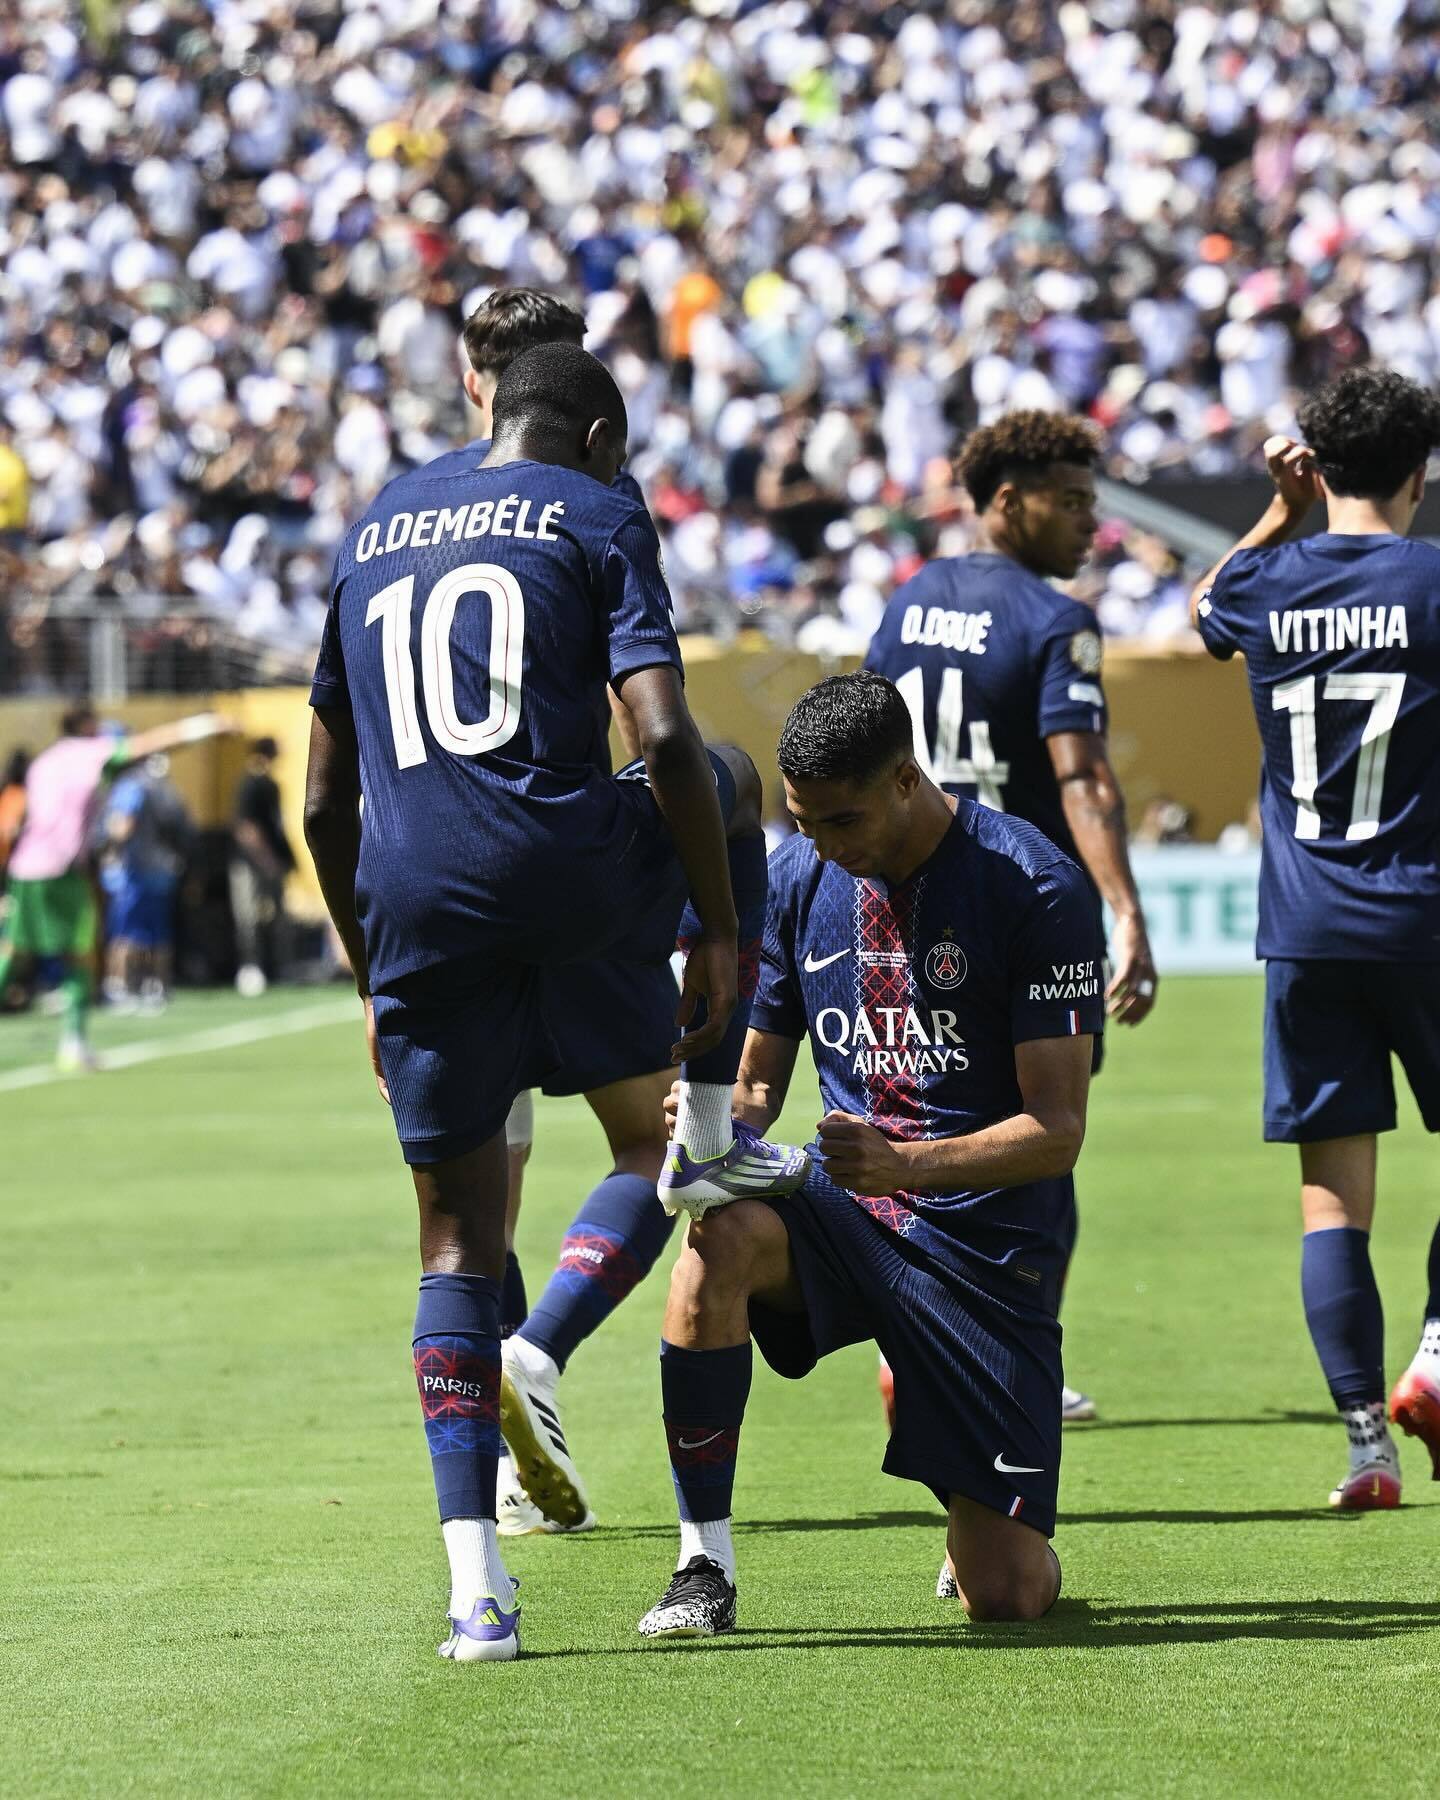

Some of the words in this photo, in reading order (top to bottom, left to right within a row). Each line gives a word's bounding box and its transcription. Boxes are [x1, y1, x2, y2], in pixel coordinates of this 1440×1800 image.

[354, 494, 565, 563] O.DEMBÉLÉ
[1269, 605, 1409, 653] VITINHA
[365, 563, 525, 770] 10
[896, 665, 1010, 812] 14
[1272, 672, 1407, 840] 17
[1136, 877, 1258, 941] TE
[933, 944, 961, 957] PARIS
[1051, 960, 1094, 981] VISIT
[815, 1007, 966, 1057] QATAR
[852, 1048, 970, 1075] AIRWAYS
[423, 1375, 482, 1397] PARIS
